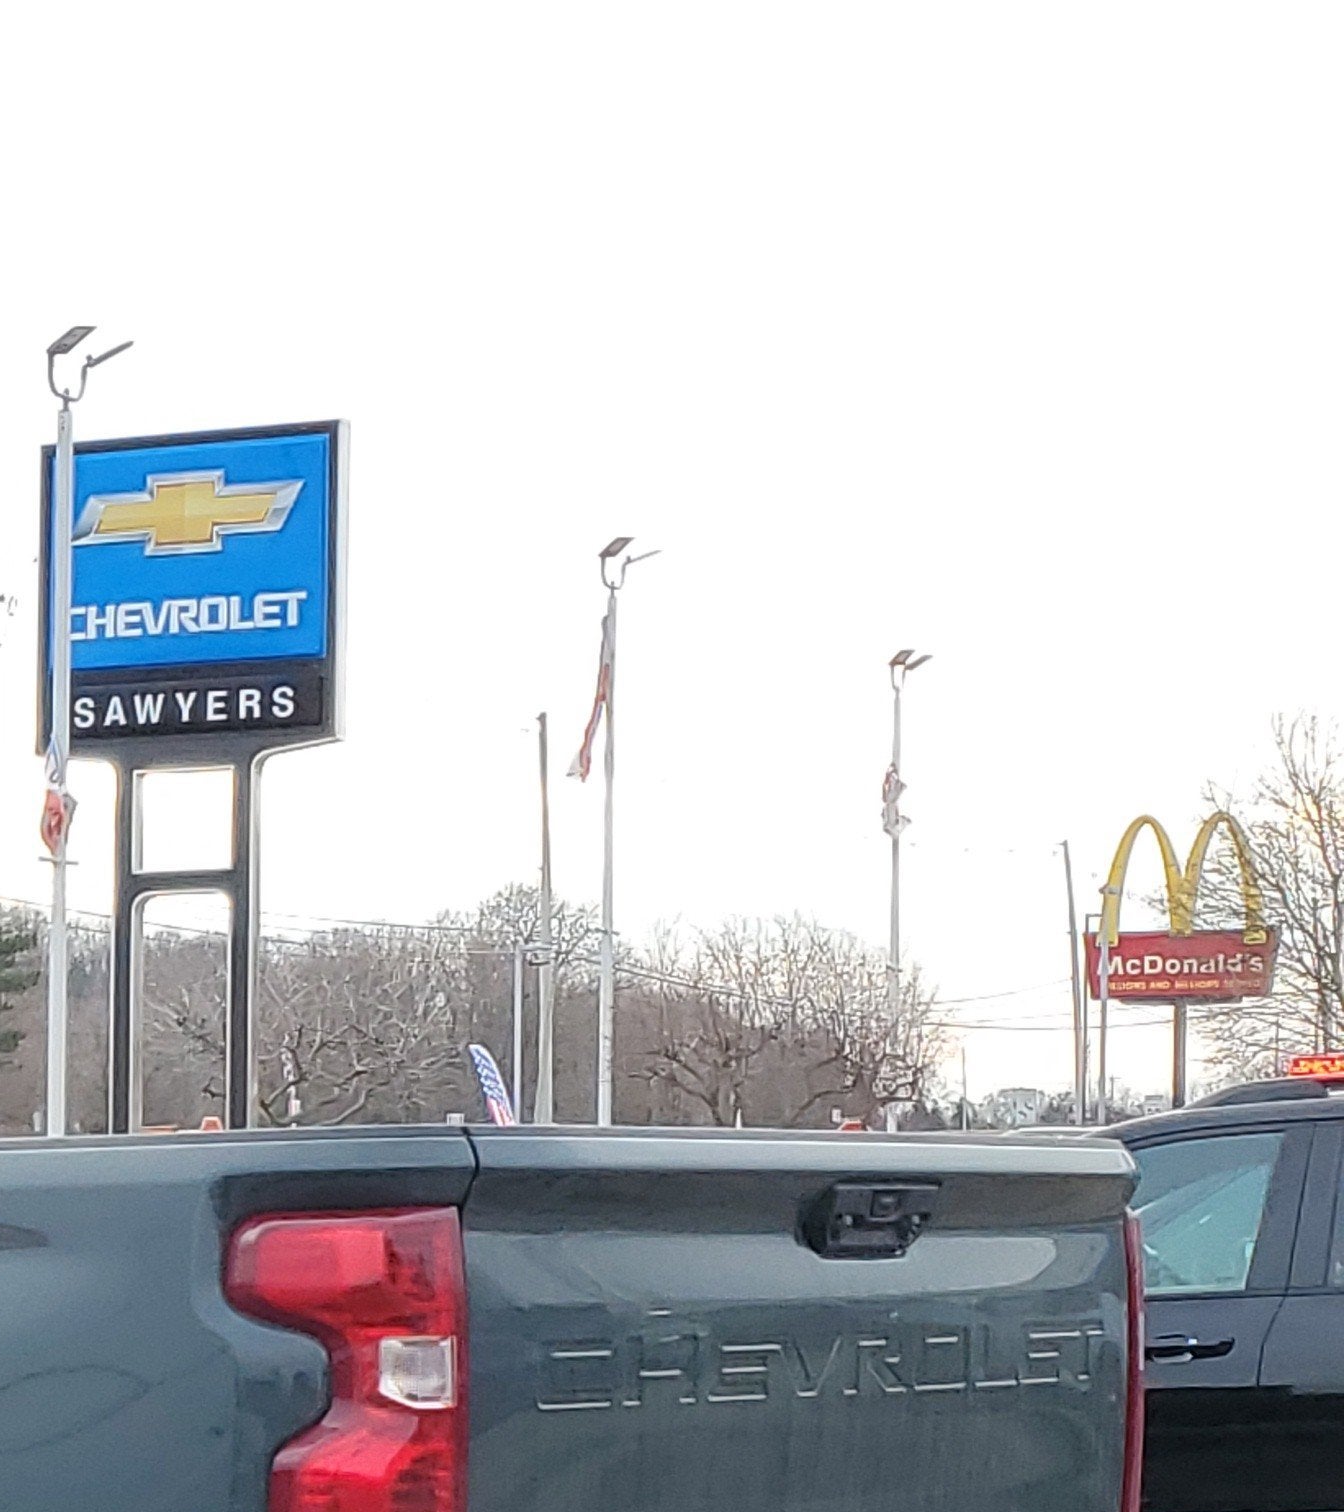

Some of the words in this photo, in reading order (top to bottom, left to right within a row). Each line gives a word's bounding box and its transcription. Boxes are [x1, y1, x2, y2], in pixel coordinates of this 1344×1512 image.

[70, 591, 307, 641] CHEVROLET
[73, 686, 295, 729] SAWYERS
[536, 1325, 1105, 1410] CHEVROLET
